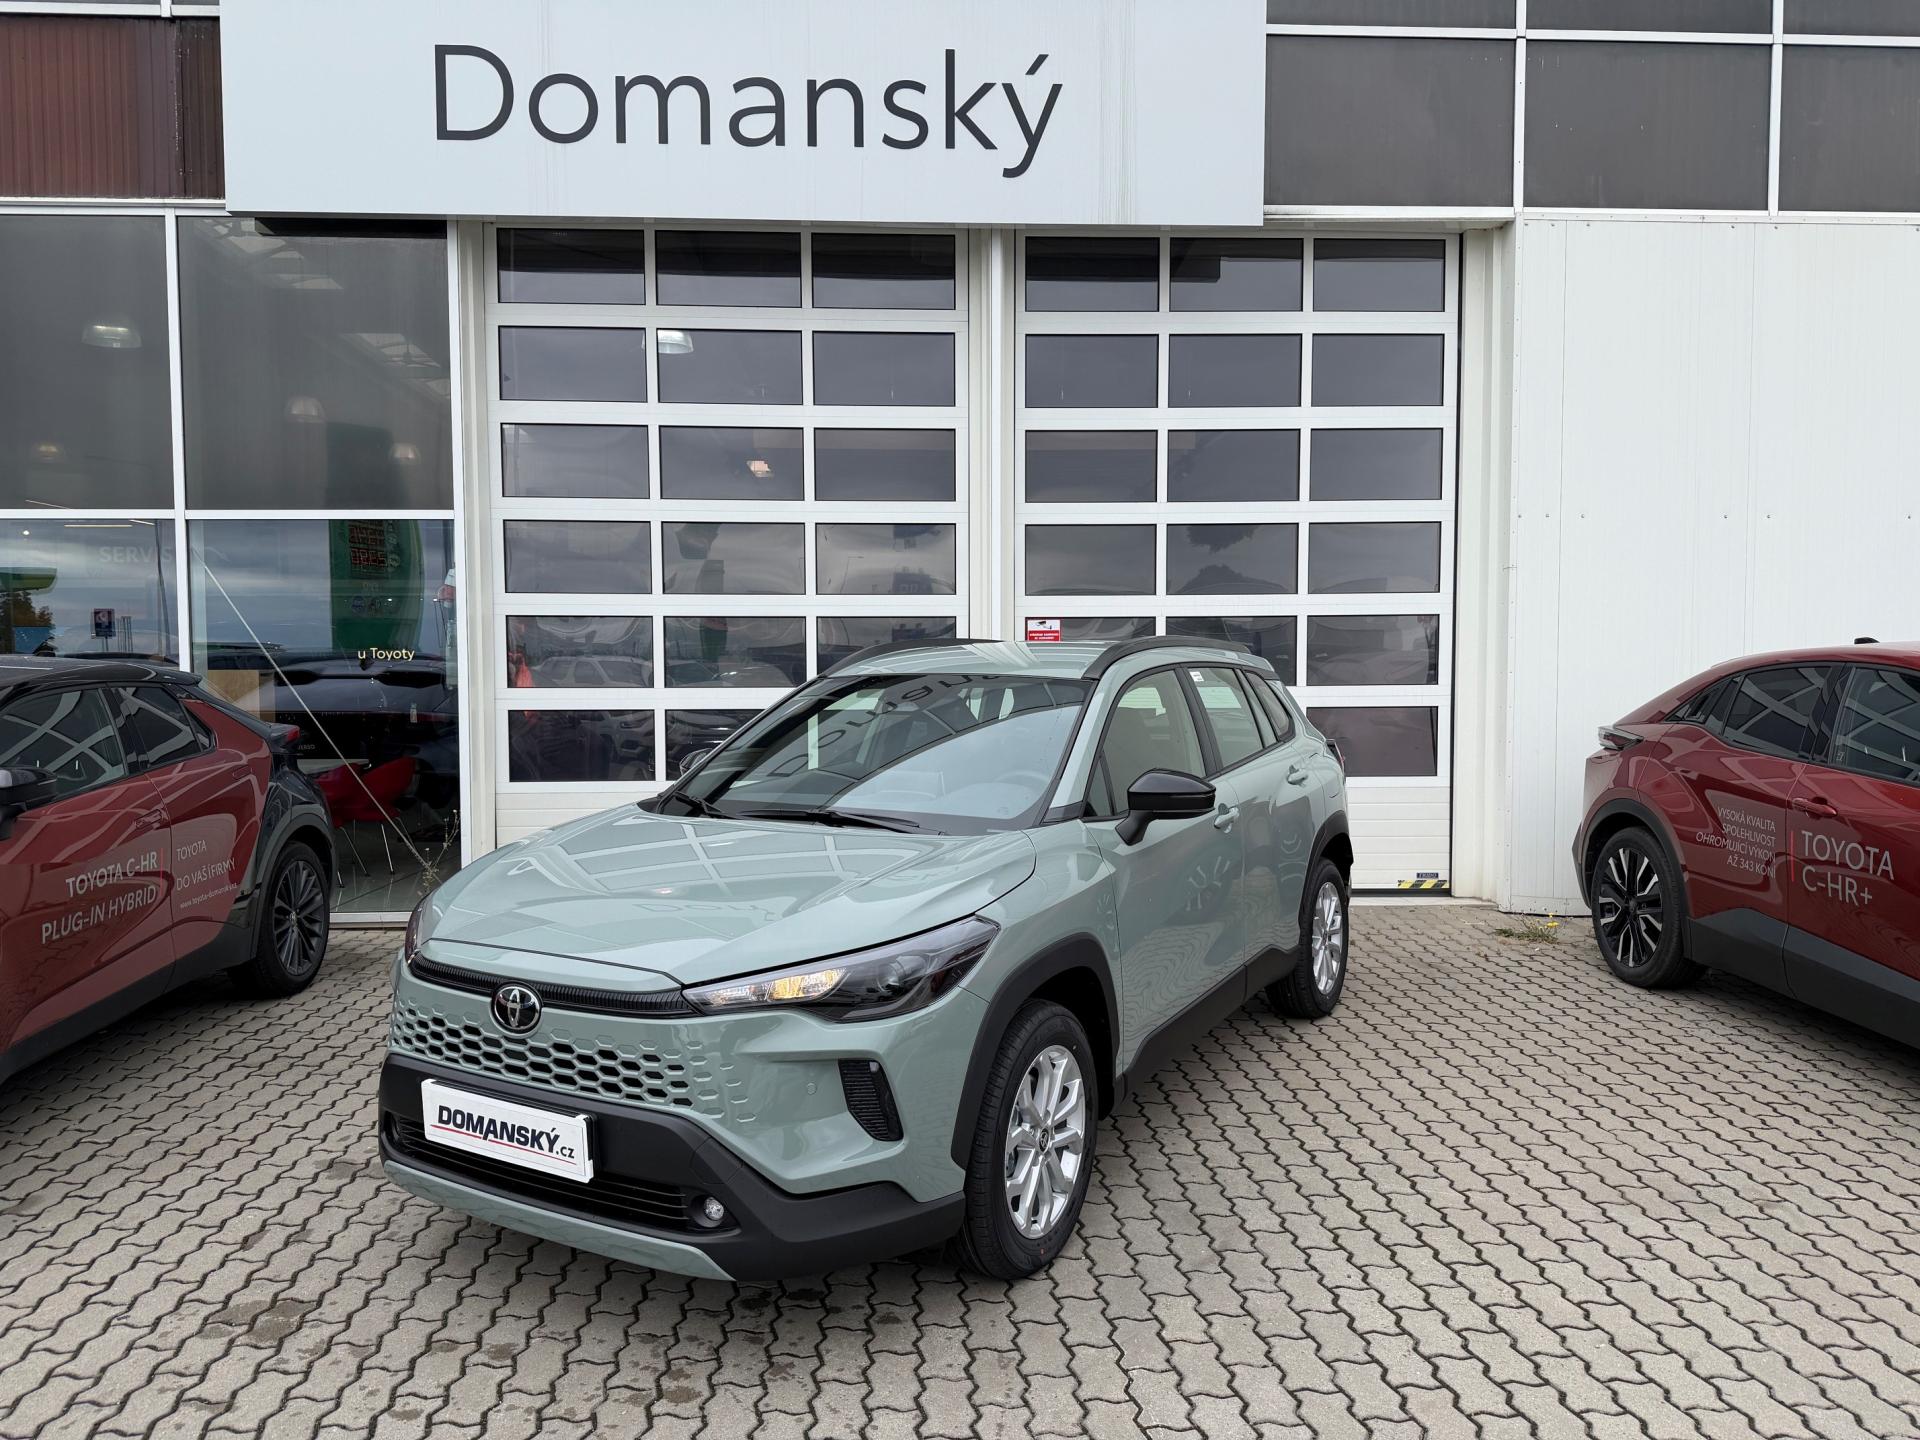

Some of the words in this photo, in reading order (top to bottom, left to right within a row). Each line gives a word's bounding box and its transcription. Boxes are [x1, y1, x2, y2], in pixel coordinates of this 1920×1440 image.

[434, 43, 1063, 179] Domanský
[100, 546, 173, 563] SERVS
[357, 649, 366, 660] u
[370, 647, 415, 661] Toyoty
[1717, 806, 1746, 824] VYSOKÁ
[1746, 815, 1776, 833] KVALITA
[1722, 823, 1776, 848] SPOLEHLIVOST
[176, 839, 207, 862] TOYOTA
[1726, 853, 1738, 867] AŽ
[1739, 858, 1754, 872] 343
[1748, 844, 1776, 863] VÝKON
[1801, 830, 1895, 880] TOYOTA
[65, 863, 124, 898] TOYOTA
[126, 851, 158, 877] C-HR
[176, 875, 190, 891] DO
[210, 857, 236, 878] FIRMY
[1802, 865, 1873, 907] C-HR+
[41, 902, 106, 944] PLUG-IN
[108, 885, 156, 919] HYBRID
